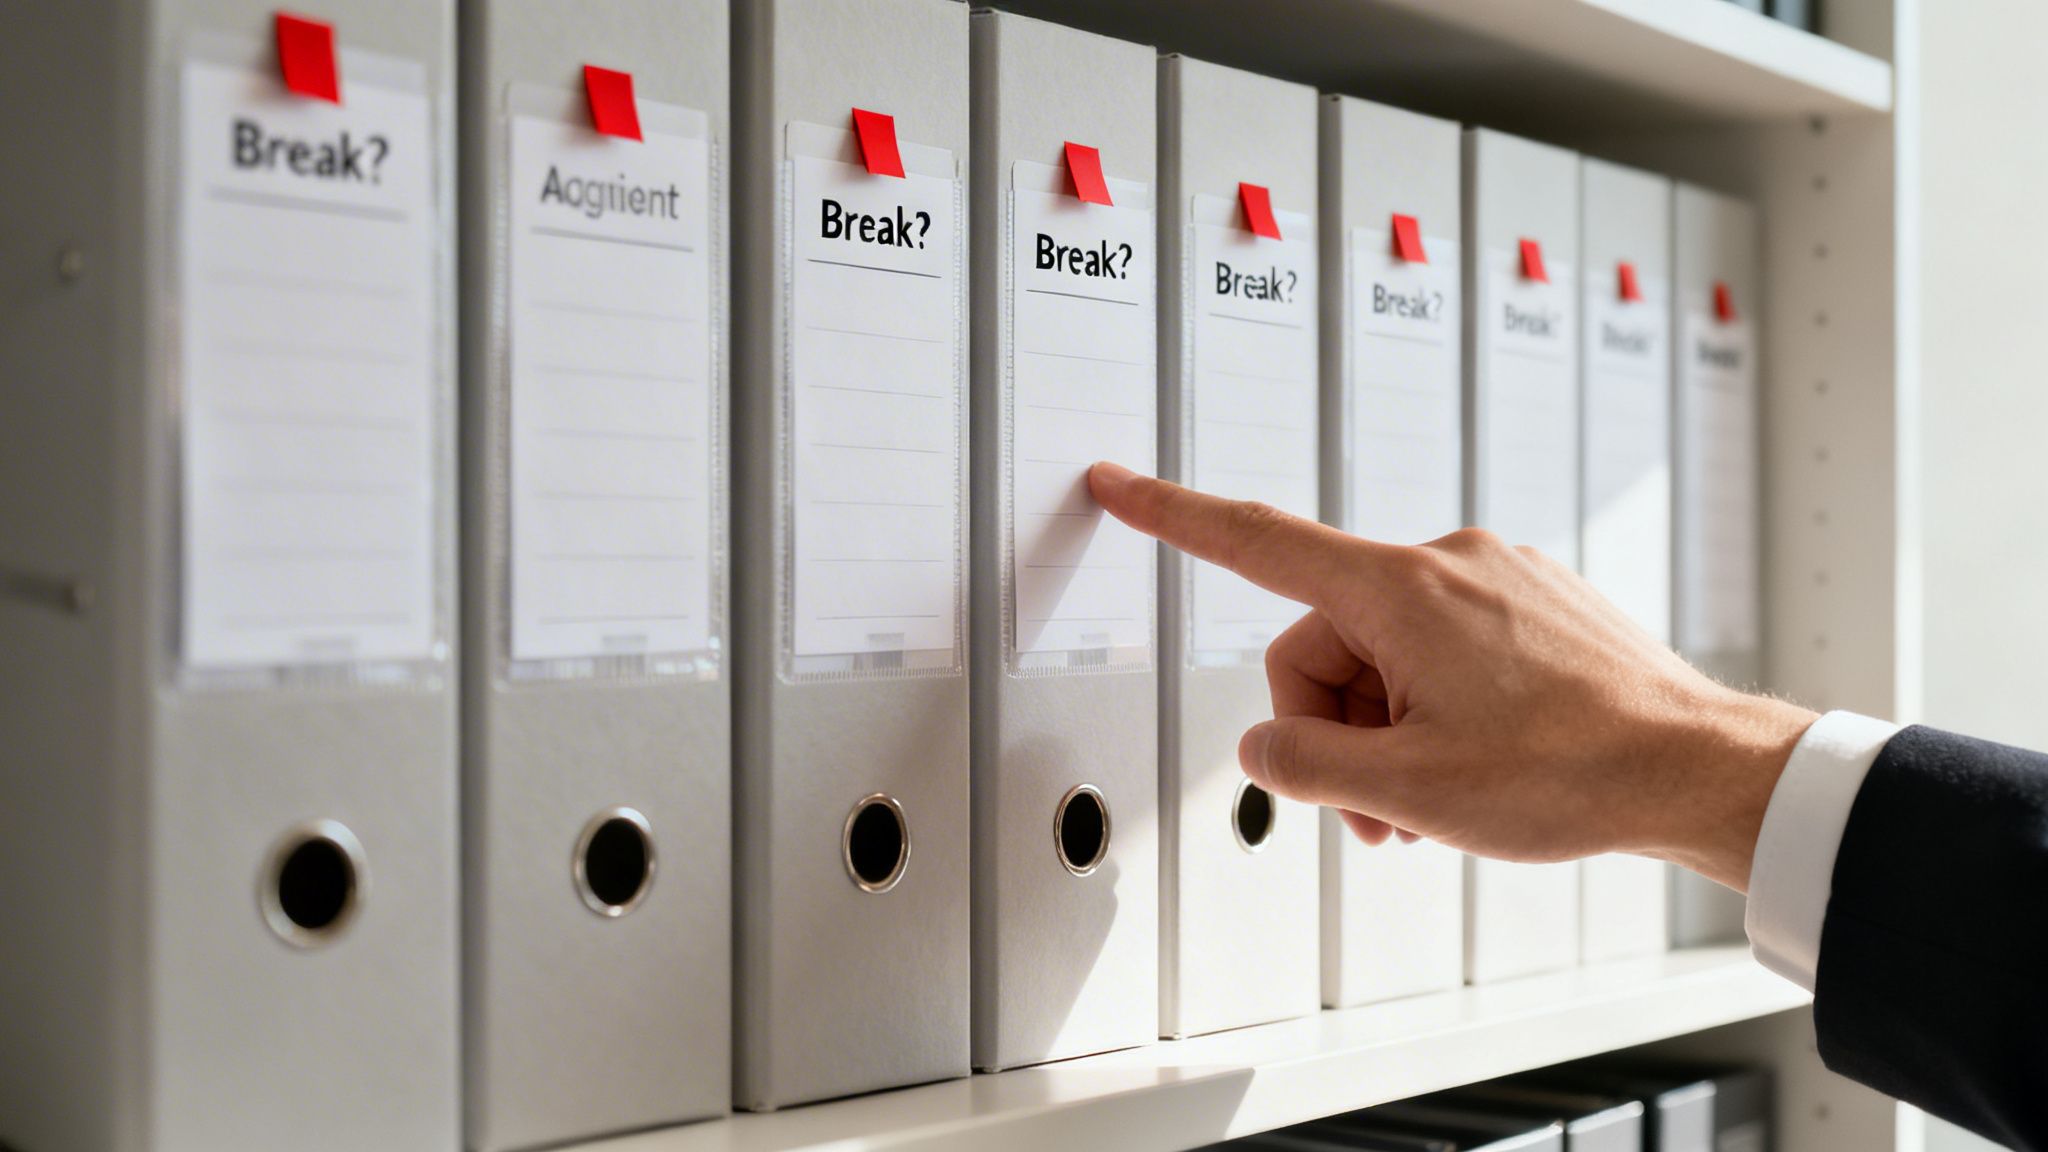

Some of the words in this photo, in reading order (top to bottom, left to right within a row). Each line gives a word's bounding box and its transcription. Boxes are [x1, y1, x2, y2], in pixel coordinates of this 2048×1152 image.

[231, 118, 390, 186] Break?
[821, 198, 932, 250] Break?
[1035, 232, 1133, 280] Break?
[1215, 261, 1297, 303] Break?
